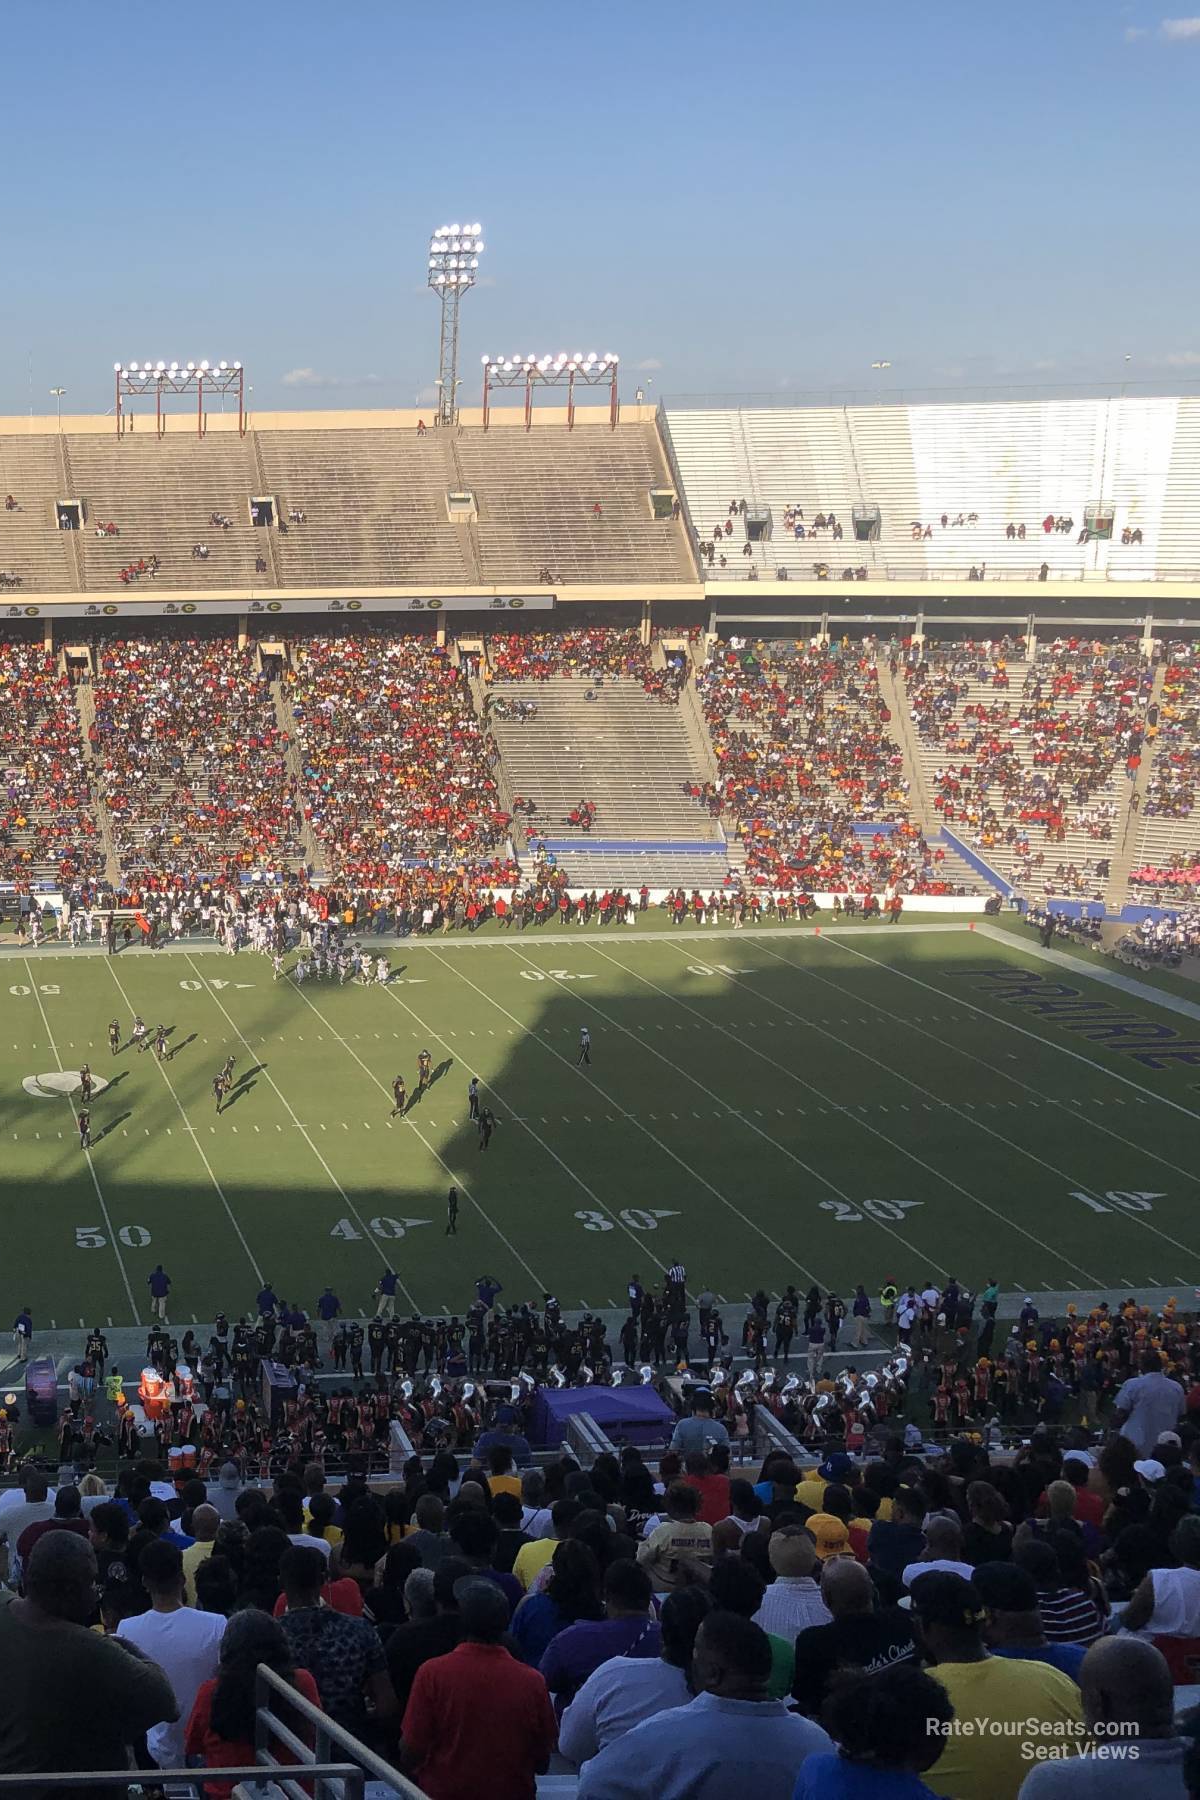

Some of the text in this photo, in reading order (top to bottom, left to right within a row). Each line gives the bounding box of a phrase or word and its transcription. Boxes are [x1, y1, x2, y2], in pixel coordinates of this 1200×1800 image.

[520, 969, 576, 981] 20
[686, 964, 740, 976] 10
[9, 984, 62, 996] 50
[179, 978, 231, 991] 40
[818, 1200, 904, 1221] 20
[1067, 1191, 1154, 1213] 10
[330, 1216, 407, 1241] 40
[574, 1208, 659, 1232] 30
[75, 1225, 152, 1249] 50
[90, 1341, 100, 1351] 35
